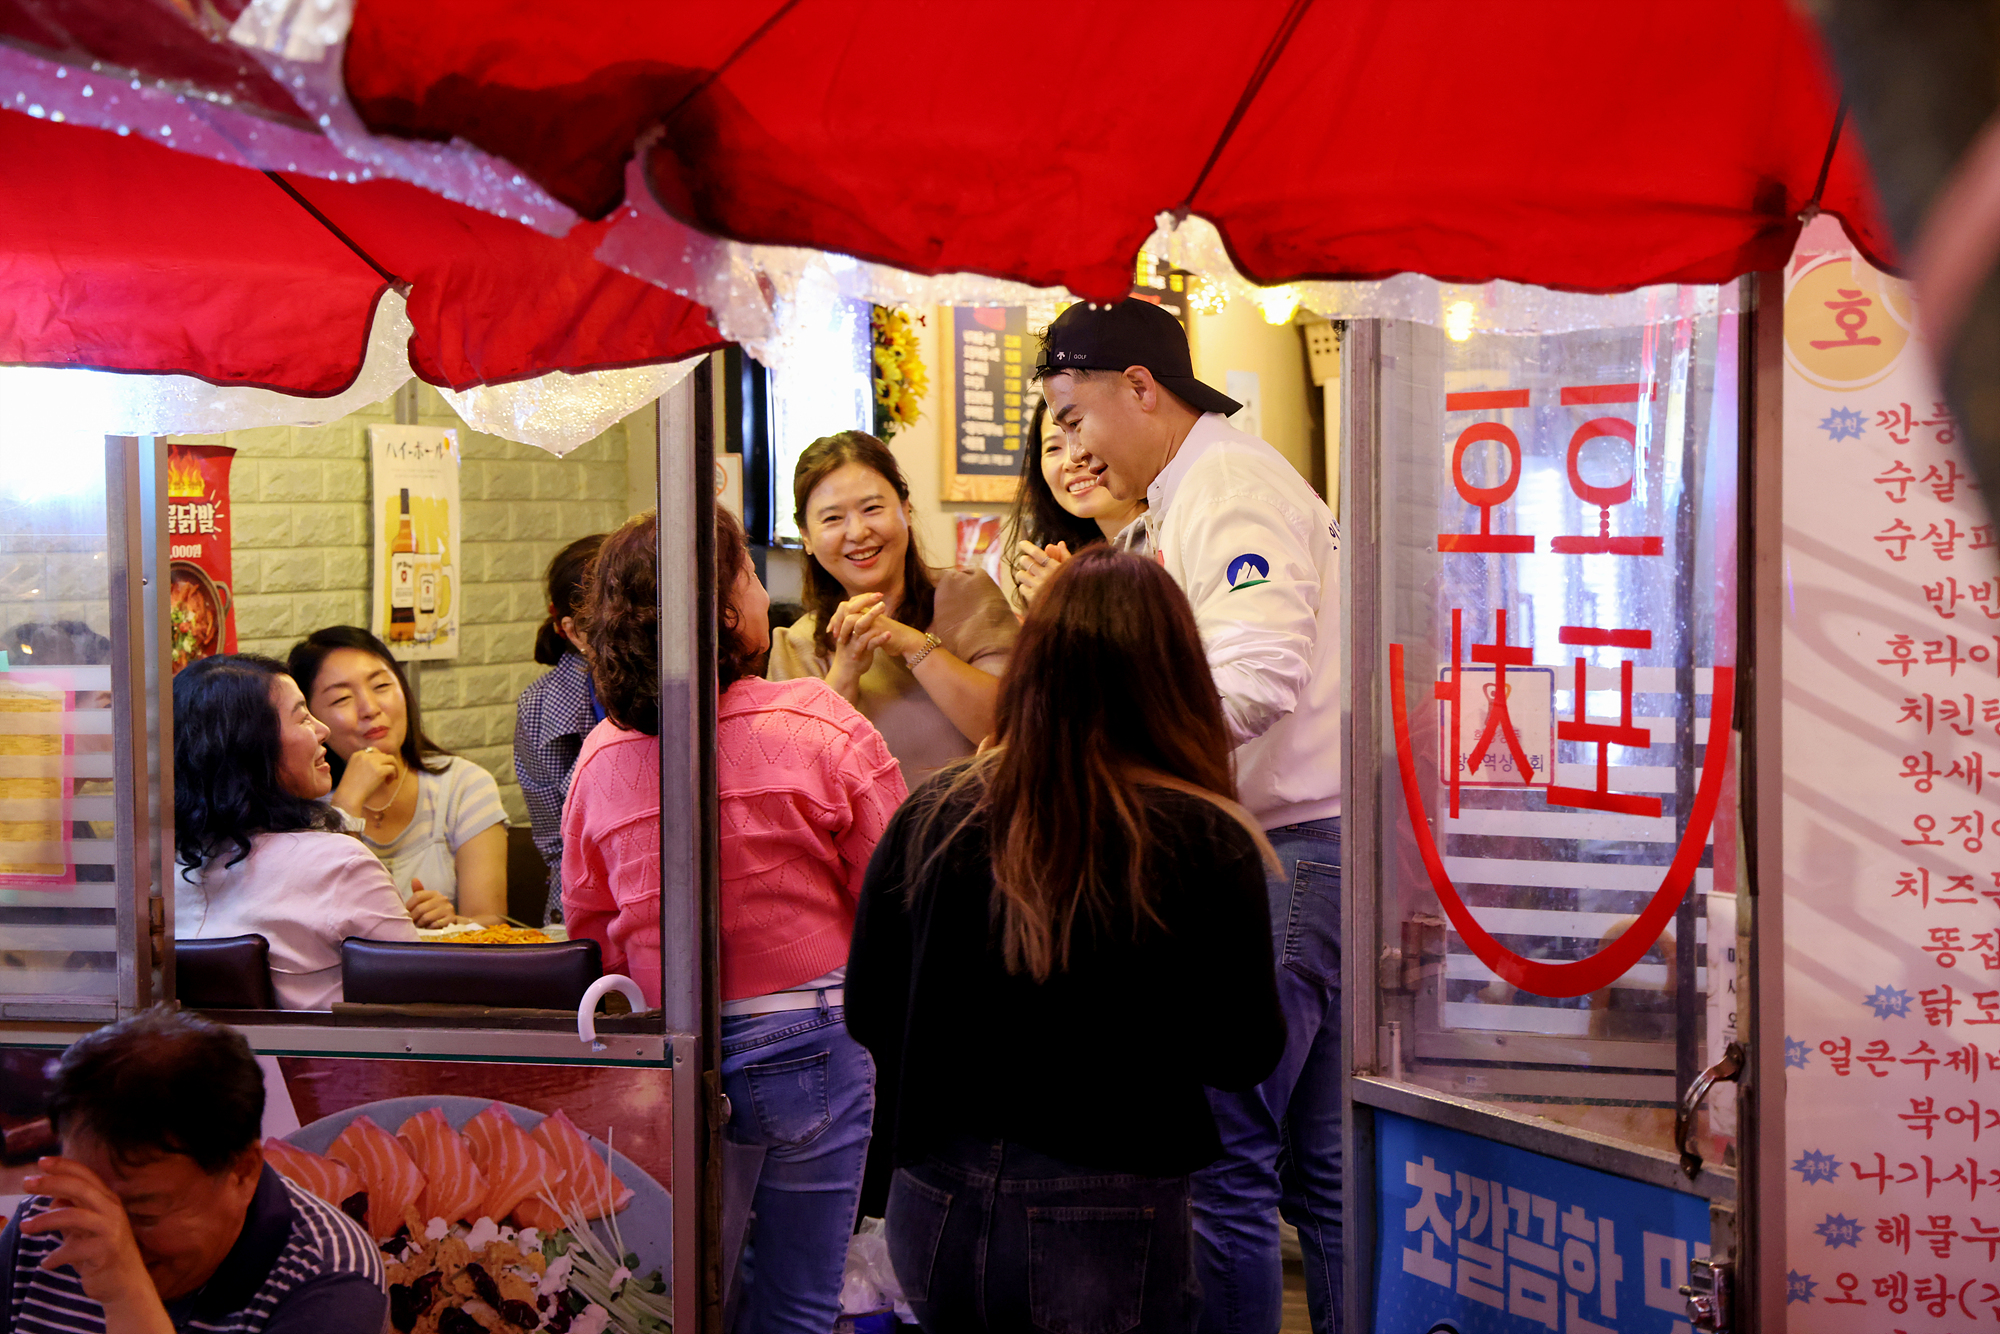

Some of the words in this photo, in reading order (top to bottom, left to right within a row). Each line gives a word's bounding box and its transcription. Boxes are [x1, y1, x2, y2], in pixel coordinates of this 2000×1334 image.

[1810, 288, 1882, 350] 호
[1874, 460, 1981, 503] 순살
[1899, 751, 2000, 794] 왕새
[1900, 810, 2000, 853] 오징
[1850, 1152, 2000, 1202] 나가사
